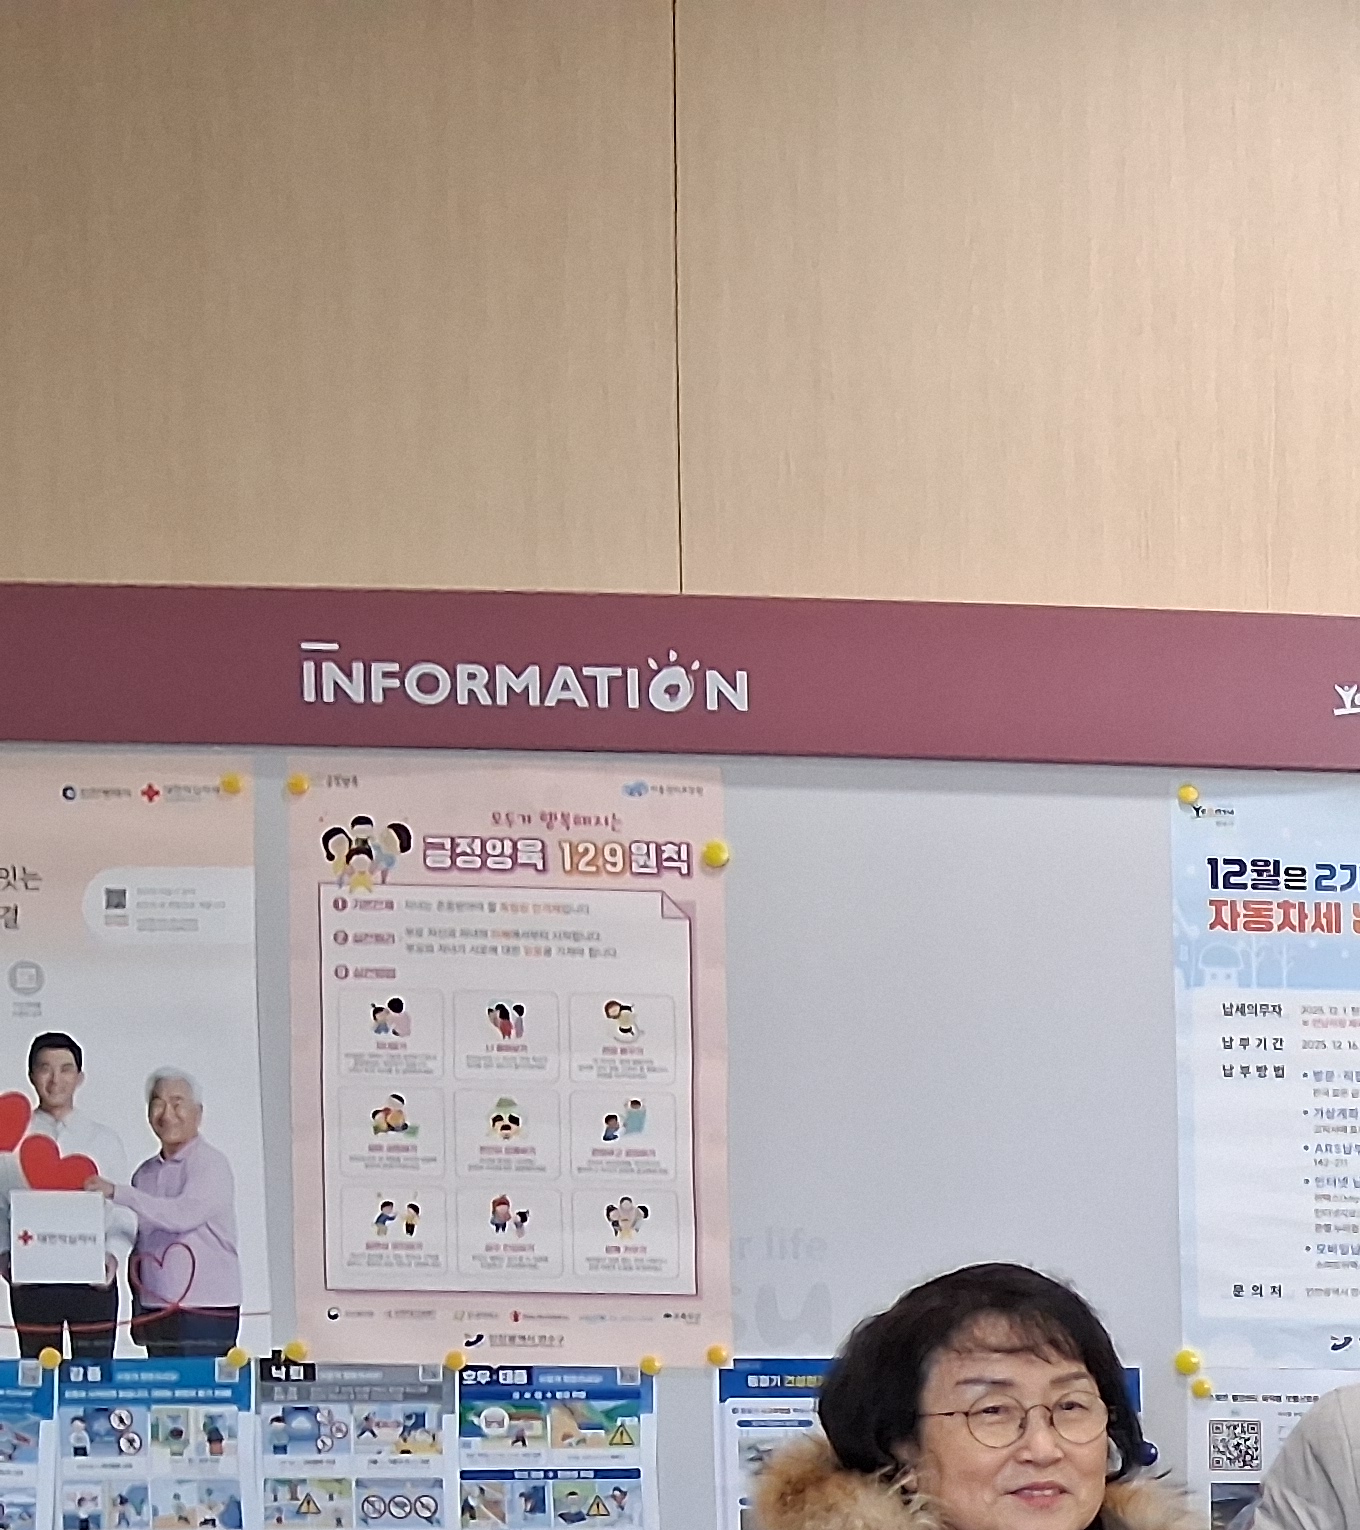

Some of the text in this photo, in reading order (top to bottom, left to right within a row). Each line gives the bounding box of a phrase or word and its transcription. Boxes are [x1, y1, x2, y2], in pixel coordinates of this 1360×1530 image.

[301, 642, 748, 712] INFORMATION
[423, 835, 692, 877] 긍정양육 129원칙
[1207, 858, 1307, 891] 12월은
[1209, 900, 1341, 934] 자동차세
[1222, 1003, 1282, 1017] 납세의무자
